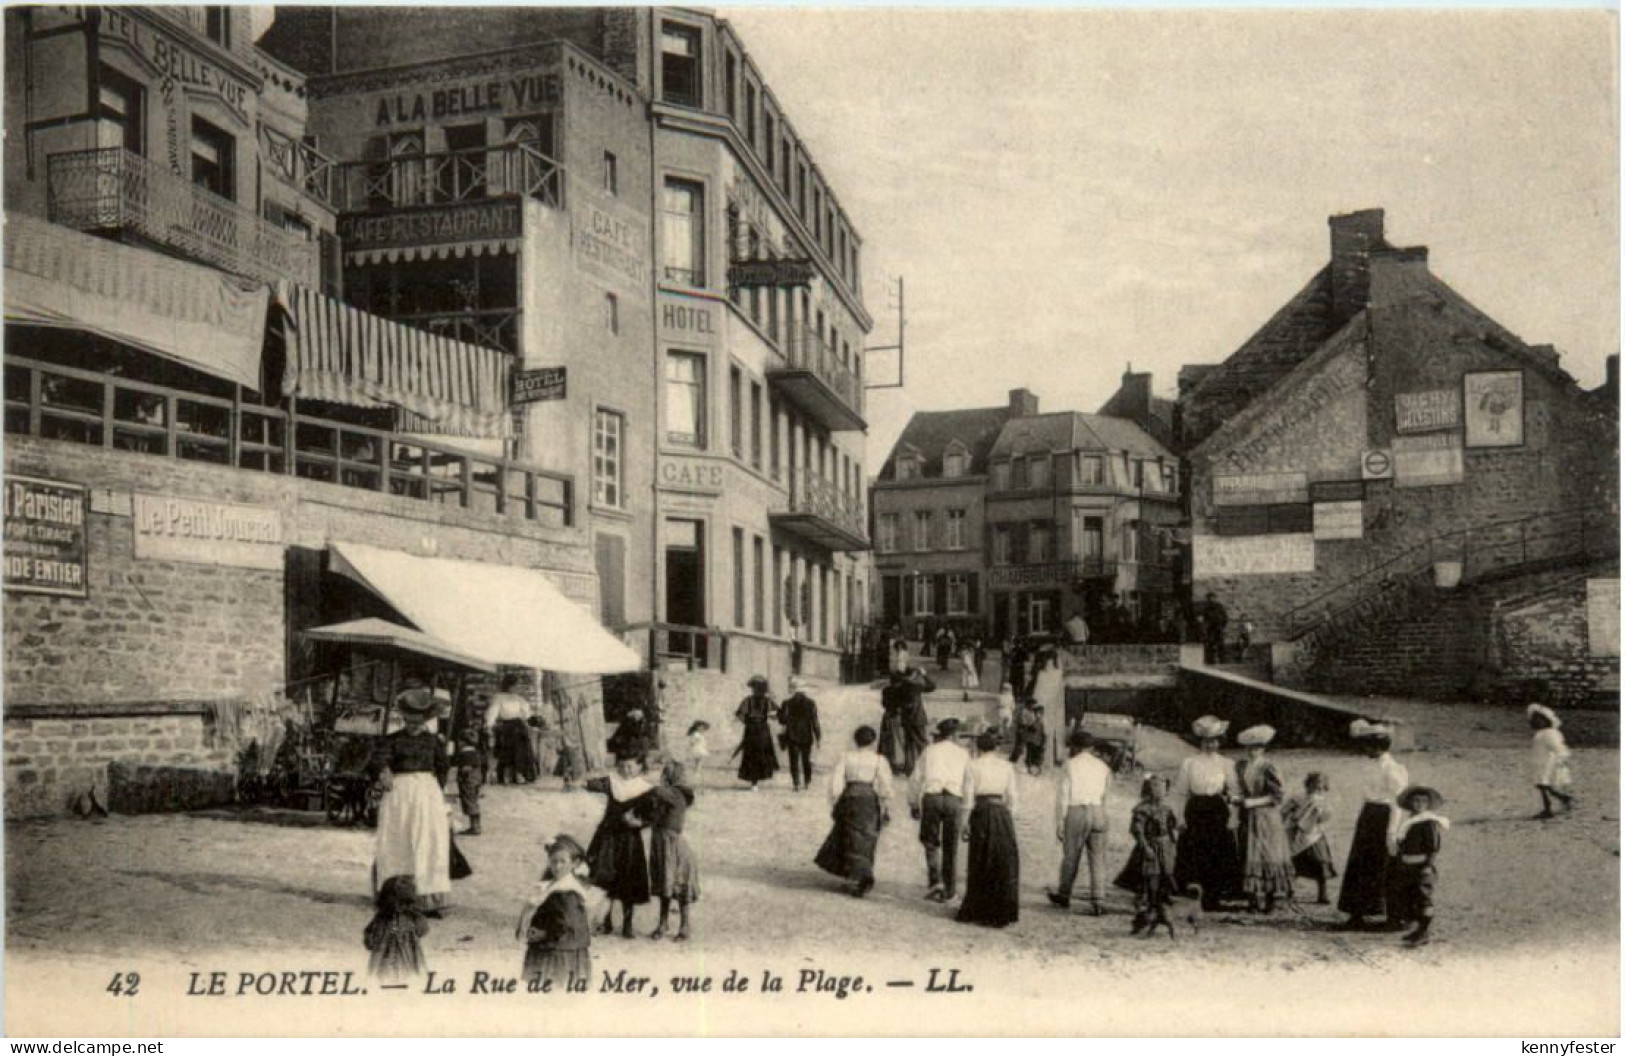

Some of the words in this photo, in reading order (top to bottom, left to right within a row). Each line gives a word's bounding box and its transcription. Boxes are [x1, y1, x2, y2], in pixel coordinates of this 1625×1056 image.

[104, 9, 143, 50] TEL
[153, 34, 211, 86] BELLE
[212, 68, 247, 118] VUE
[396, 93, 426, 122] LA
[432, 83, 502, 118] BELLE
[510, 74, 565, 107] VUE
[391, 206, 517, 241] RESTAURANT
[663, 304, 716, 334] HOTEL
[514, 372, 564, 392] HOTEL
[13, 483, 82, 526] Parisien
[139, 496, 164, 536] Le
[166, 500, 212, 540] Petit
[35, 559, 81, 584] ENTIER
